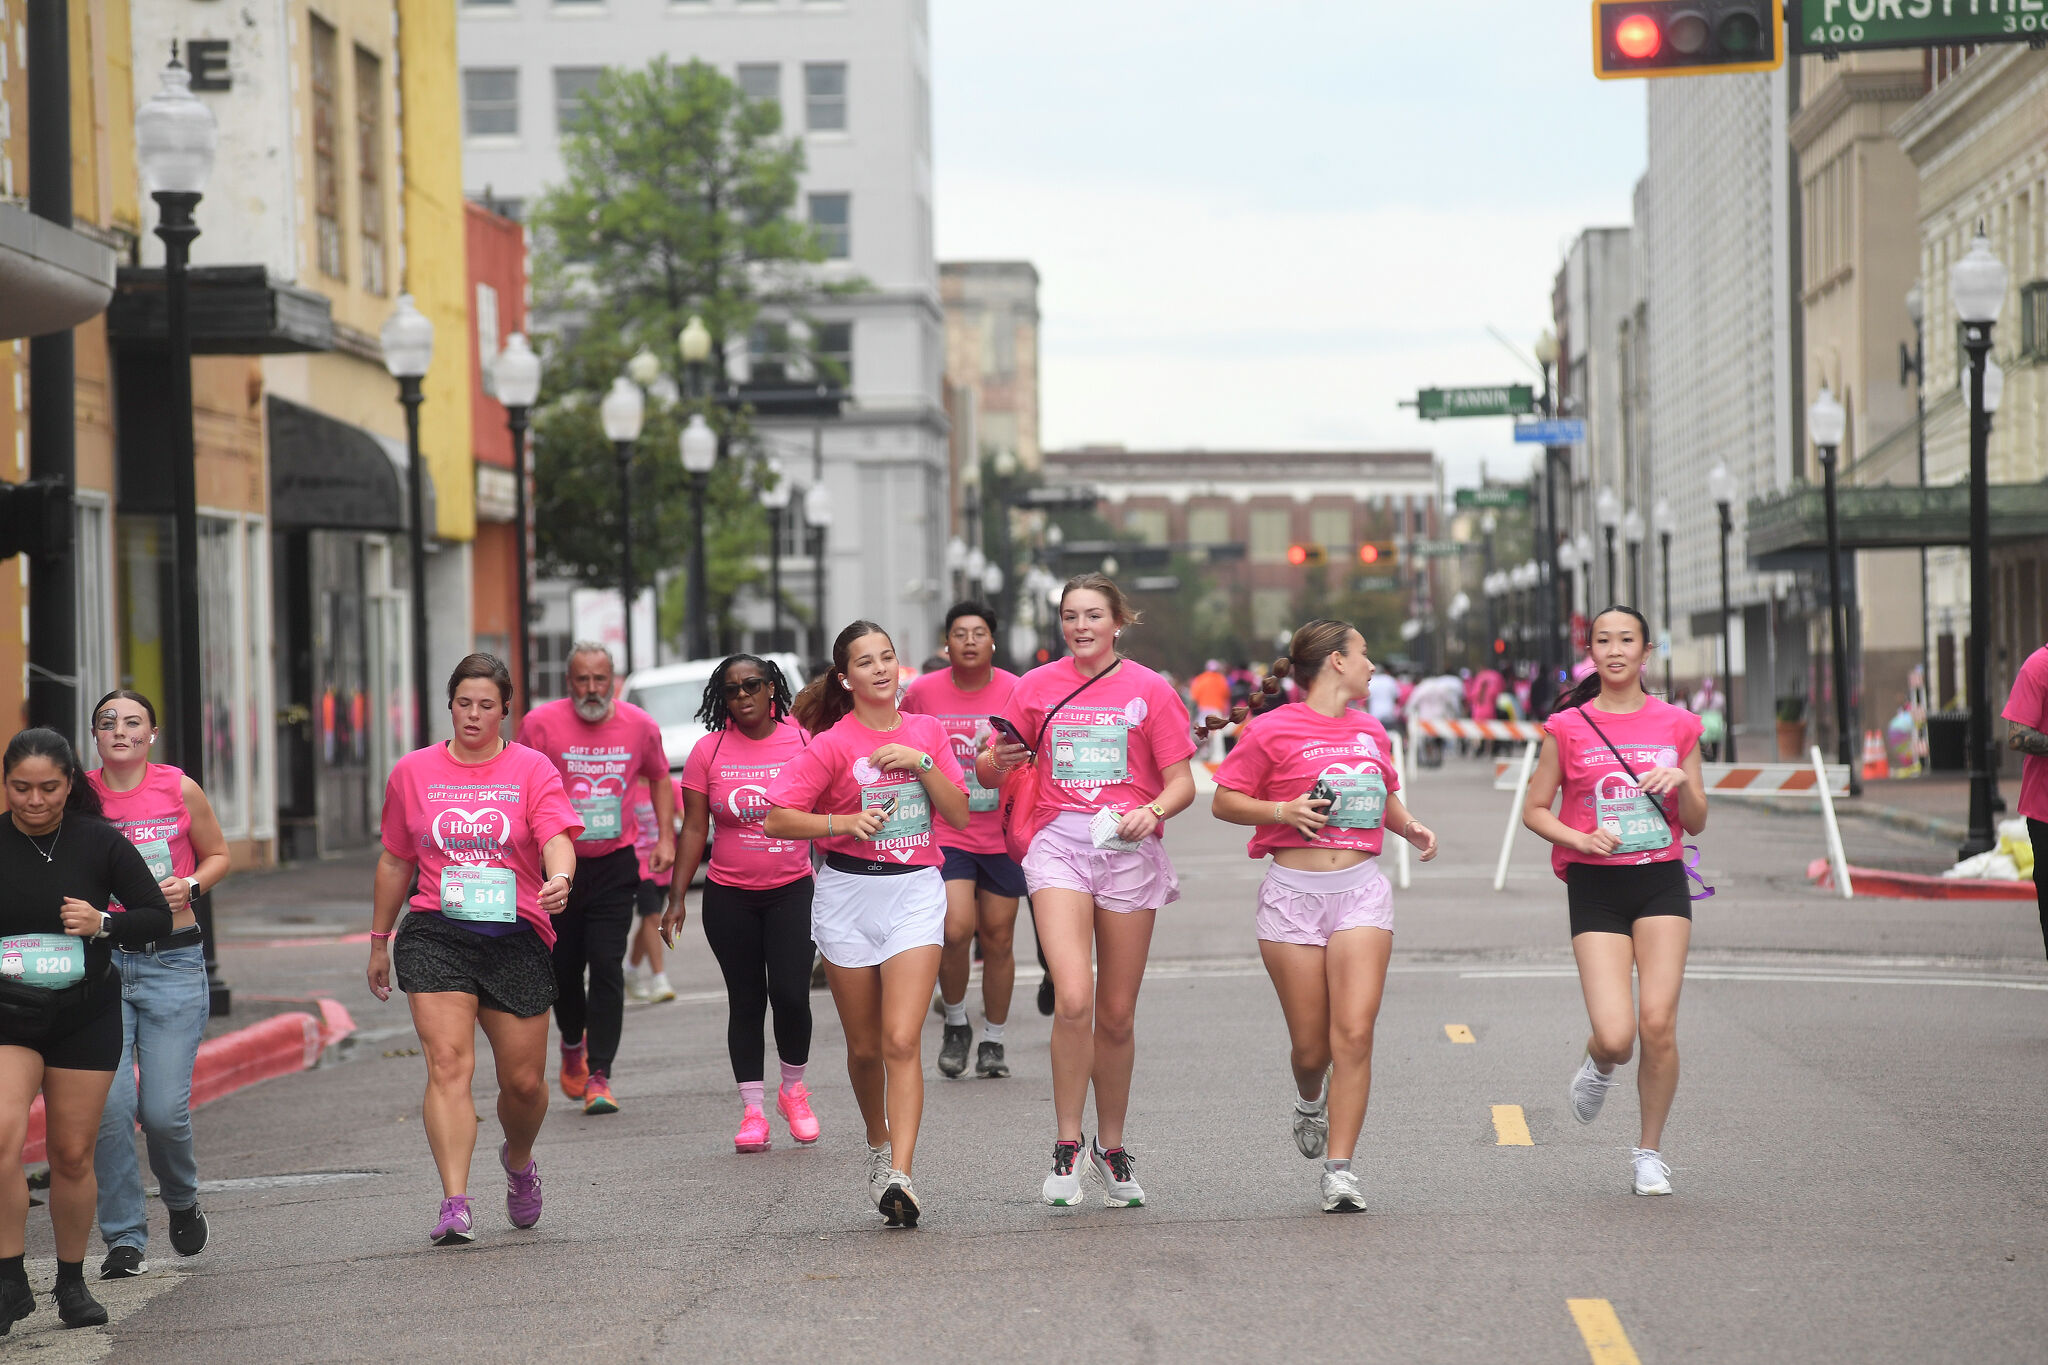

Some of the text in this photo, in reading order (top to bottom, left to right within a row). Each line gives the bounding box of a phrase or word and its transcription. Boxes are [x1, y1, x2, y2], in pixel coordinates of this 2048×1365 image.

[1823, 0, 2044, 22] FORS
[1810, 24, 1864, 43] 400
[187, 40, 233, 93] E
[1443, 388, 1509, 408] FANNIN
[1071, 713, 1091, 721] LIFE
[1095, 714, 1116, 725] 5K
[569, 746, 589, 754] GIFT
[608, 746, 625, 754] LIFE
[1079, 747, 1120, 762] 2629
[1302, 748, 1324, 758] GIFT
[1353, 746, 1371, 757] 5K
[1584, 755, 1605, 764] GIFT
[1638, 751, 1657, 763] 5K
[567, 761, 626, 774] Ribbon Run
[769, 768, 780, 778] 5
[886, 772, 904, 780] LIFE
[428, 792, 447, 800] GIFT
[454, 792, 474, 800] LIFE
[478, 790, 498, 800] 5K
[499, 795, 520, 804] RUN
[866, 792, 882, 800] 5K
[882, 792, 899, 800] RUN
[1344, 796, 1380, 811] 2594
[1601, 804, 1616, 812] 5K
[893, 802, 926, 821] 1604
[146, 817, 178, 825] PROCTER
[592, 814, 615, 827] 638
[135, 826, 156, 840] 5K
[156, 830, 178, 838] RUN
[450, 821, 492, 837] Hope
[444, 836, 498, 850] Health
[874, 831, 930, 850] Healing
[868, 862, 882, 870] alo
[475, 888, 506, 904] 514
[2, 940, 20, 949] 5K
[36, 956, 72, 974] 820
